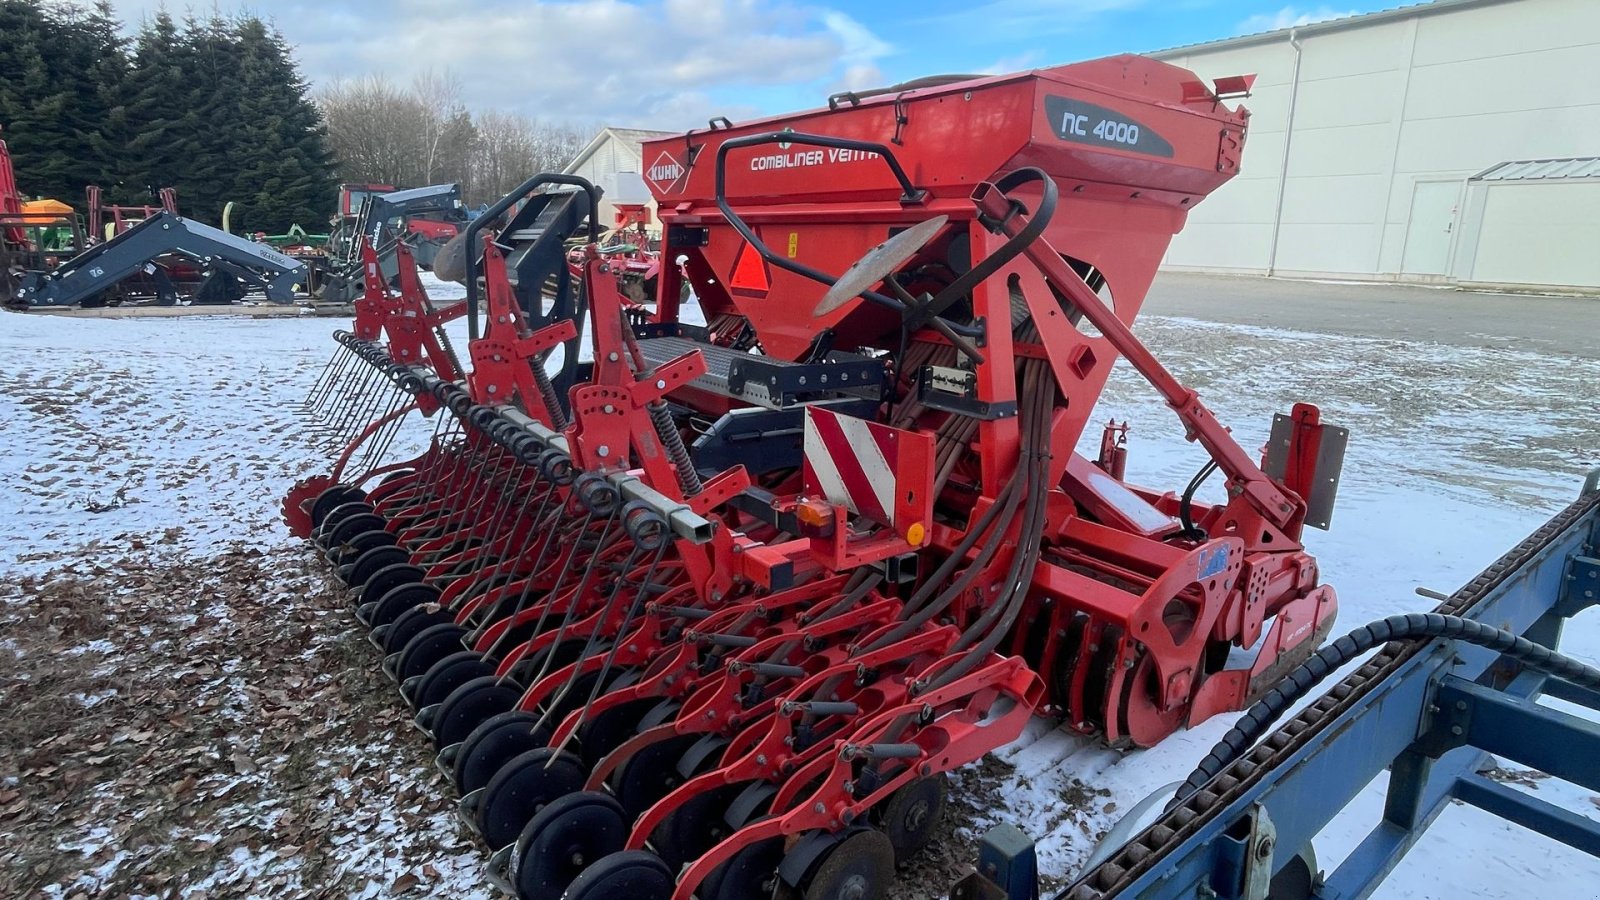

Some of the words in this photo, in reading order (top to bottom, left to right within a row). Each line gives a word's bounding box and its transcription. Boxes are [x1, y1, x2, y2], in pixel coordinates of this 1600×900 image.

[1093, 119, 1139, 145] 4000
[751, 151, 823, 171] COMBILINER
[651, 164, 679, 181] KUHN
